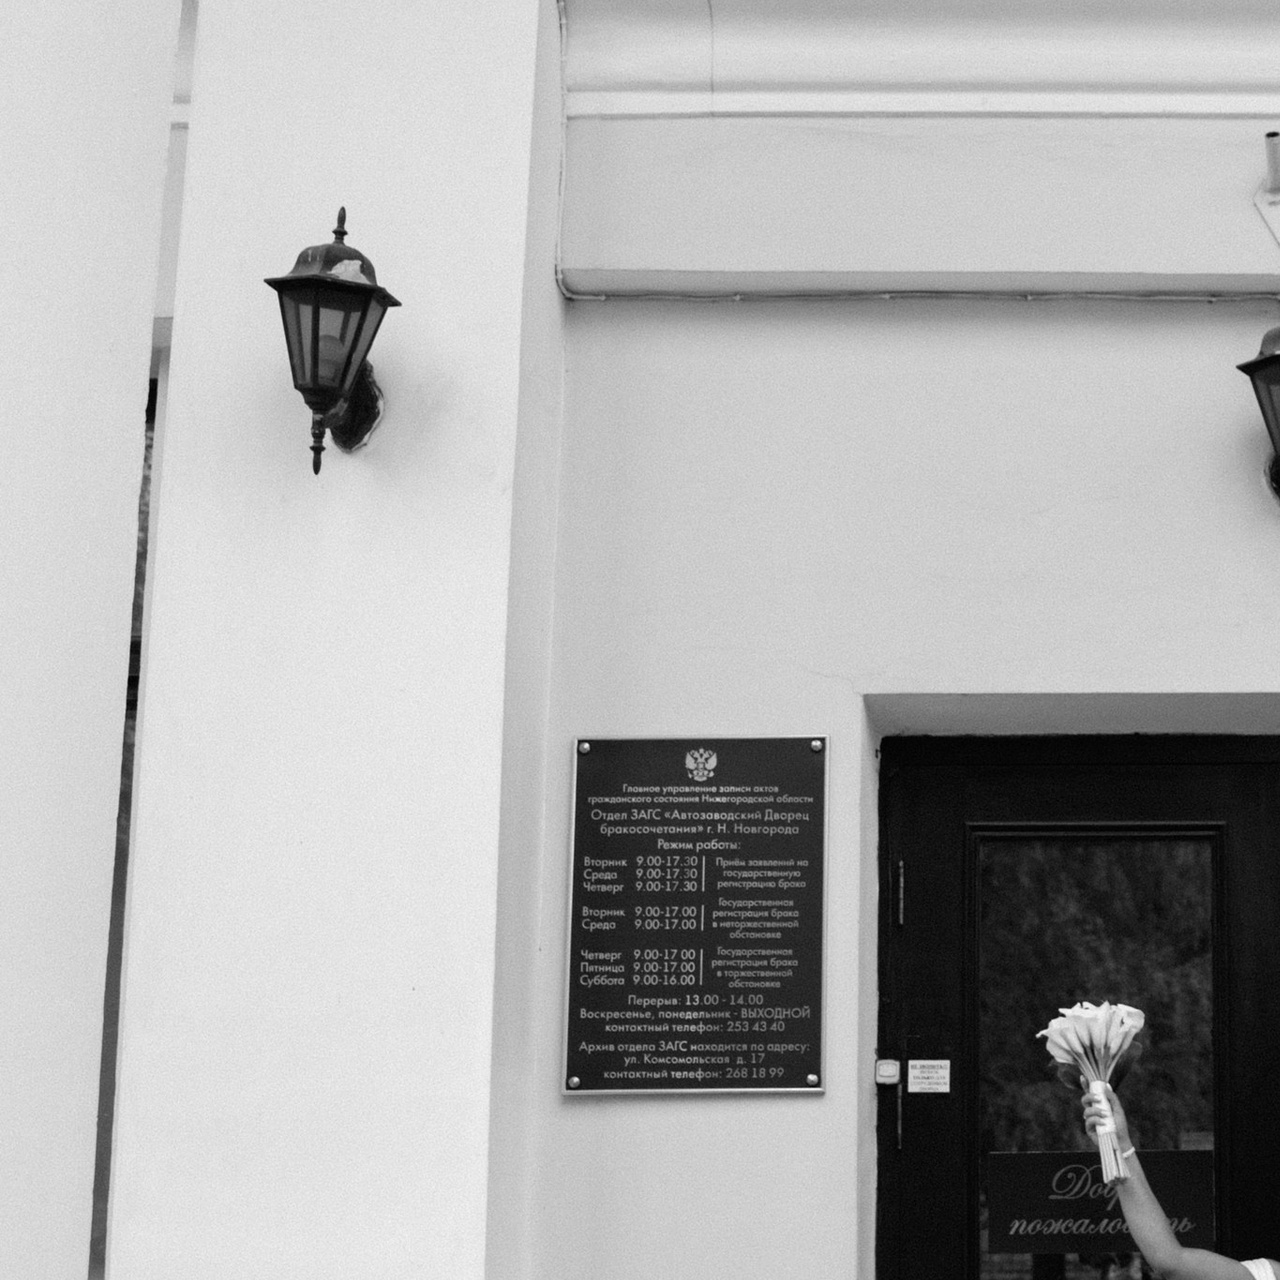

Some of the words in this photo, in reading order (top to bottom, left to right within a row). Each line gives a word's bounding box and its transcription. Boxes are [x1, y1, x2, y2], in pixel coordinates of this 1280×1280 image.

[623, 784, 660, 792] Главное
[662, 786, 717, 795] управление
[588, 796, 651, 805] гражданского
[702, 794, 774, 805] Нижегородской
[776, 794, 813, 803] области
[591, 809, 627, 821] Отдел
[631, 809, 661, 820] ЗАГС
[665, 809, 761, 821] «Автозаводский
[765, 809, 809, 823] Дворец
[600, 823, 703, 837] бракосочетания»
[718, 824, 730, 833] Н.
[734, 824, 799, 836] Новгорода
[658, 839, 693, 849] Режим
[696, 839, 740, 852] работы:
[584, 856, 627, 869] Вторник
[636, 856, 698, 866] 9.00-17.30
[584, 869, 617, 882] Среда
[636, 868, 698, 879] 9.00-17.30
[723, 871, 801, 879] государственную
[583, 882, 624, 894] Четверг
[636, 881, 697, 892] 9.00-17.30
[717, 881, 776, 890] регистрацию
[778, 879, 806, 890] брака
[719, 897, 794, 908] Государственная
[582, 906, 625, 919] Вторник
[635, 906, 696, 917] 9.00-17.00
[713, 910, 768, 919] регистрация
[771, 908, 799, 919] брака
[582, 919, 616, 932] Среда
[635, 919, 696, 930] 9.00-17.00
[720, 920, 799, 930] неторжественной
[730, 930, 782, 939] обстановке
[581, 949, 622, 962] Четверг
[717, 946, 793, 958] Государственная
[581, 962, 624, 973] Пятница
[633, 962, 695, 972] 9.00-17.00
[712, 959, 768, 968] регистрация
[770, 958, 798, 969] брака
[580, 975, 624, 987] Суббота
[633, 974, 695, 985] 9.00-16.00
[725, 969, 792, 979] торжественной
[728, 979, 780, 988] обстановке
[628, 995, 681, 1008] Перерыв:
[686, 995, 719, 1005] 13.00
[730, 995, 763, 1005] 14.00
[580, 1008, 654, 1021] Воскресенье,
[659, 1011, 731, 1019] понедельник
[742, 1006, 810, 1019] ВЫХОДНОЙ
[605, 1023, 669, 1032] контактный
[672, 1021, 723, 1034] телефон:
[727, 1021, 749, 1031] 253
[752, 1021, 766, 1031] 43
[770, 1021, 785, 1031] 40
[579, 1042, 614, 1054] Архив
[618, 1044, 655, 1052] отдела
[659, 1041, 687, 1051] ЗАГС
[691, 1044, 747, 1052] находится
[767, 1044, 810, 1054] адресу:
[624, 1056, 640, 1067] ул.
[644, 1054, 729, 1063] Комсомольская
[737, 1056, 746, 1064] д.
[752, 1053, 765, 1063] 17
[604, 1070, 668, 1078] контактный
[671, 1068, 722, 1081] телефон:
[726, 1068, 748, 1078] 268
[752, 1068, 766, 1078] 18
[769, 1067, 784, 1078] 99
